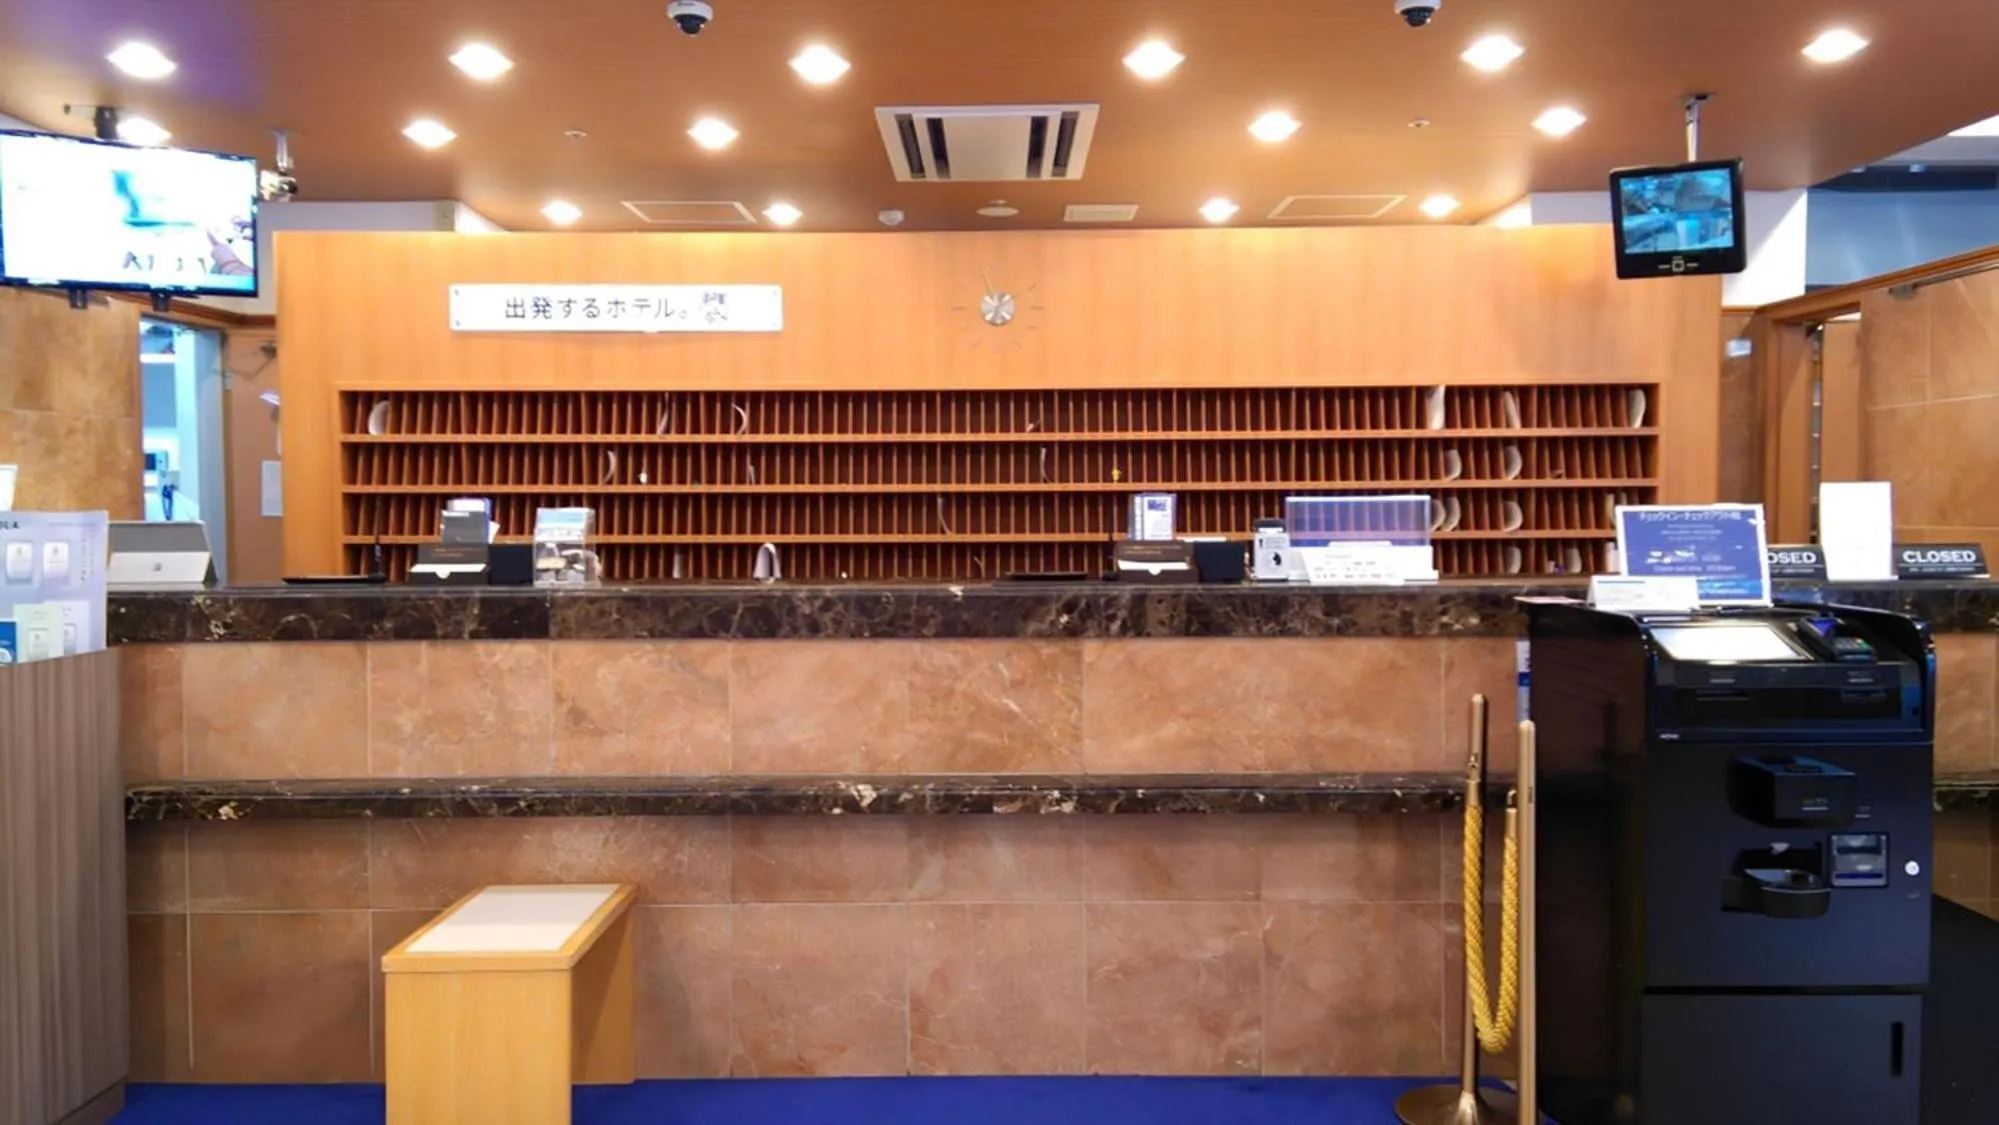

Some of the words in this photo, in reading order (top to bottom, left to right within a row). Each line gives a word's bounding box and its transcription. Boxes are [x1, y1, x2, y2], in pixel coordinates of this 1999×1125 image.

[505, 297, 688, 320] 出発するホテル。
[1902, 550, 1977, 563] CLOSED
